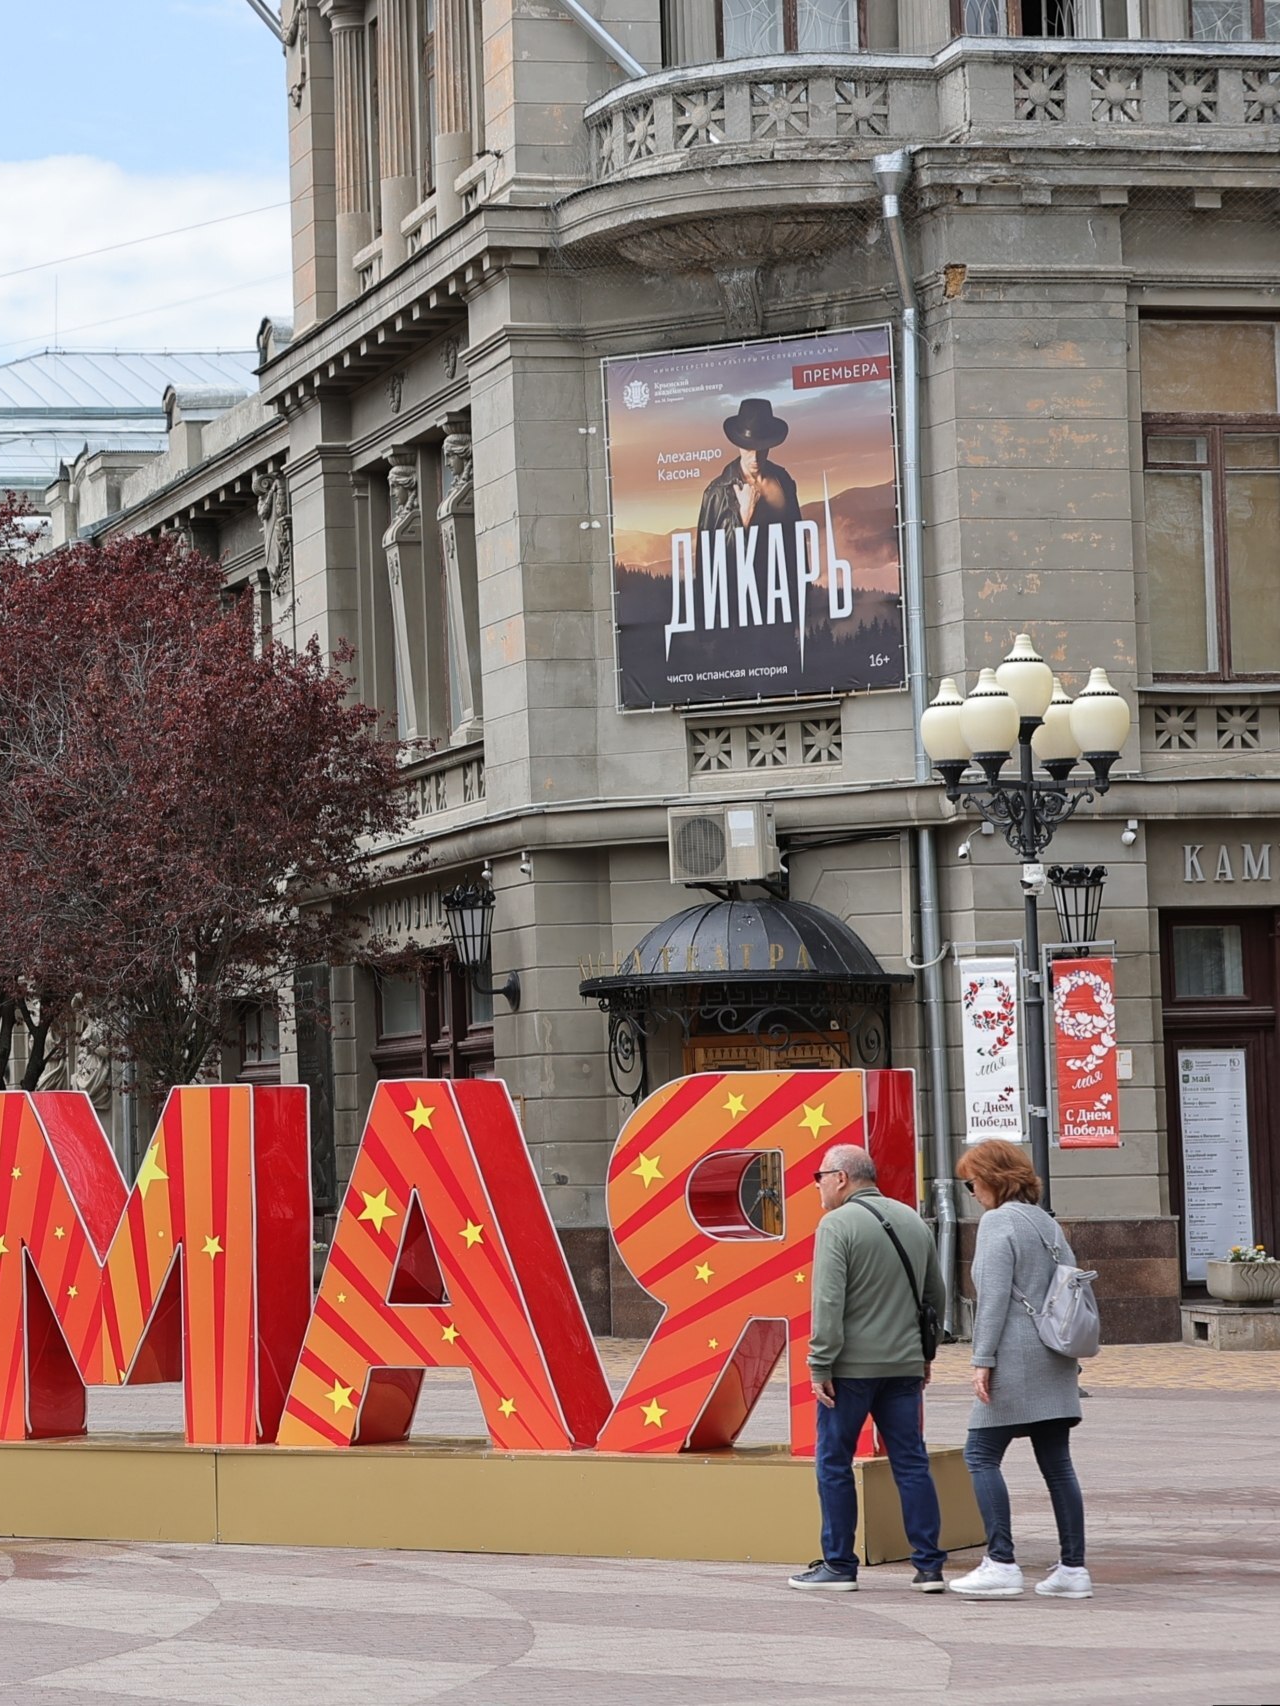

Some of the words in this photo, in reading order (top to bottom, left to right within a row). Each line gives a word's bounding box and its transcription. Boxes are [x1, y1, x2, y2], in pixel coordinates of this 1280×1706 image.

[653, 361, 715, 374] МИНИСТЕРСТВО
[718, 356, 758, 366] КУЛЬТУРЫ
[761, 350, 814, 361] РЕСПУБЛИКИ
[803, 363, 879, 383] ПРЕМЬЕРА
[654, 379, 689, 390] Крымский
[657, 448, 722, 464] Алехандро
[657, 468, 700, 481] Касона
[664, 469, 853, 674] ДИКАРЬ
[869, 653, 891, 667] 16+
[667, 673, 694, 683] чисто
[696, 668, 746, 681] испанская
[748, 665, 788, 678] история
[1182, 843, 1280, 882] КАМ
[659, 943, 810, 973] ТЕАТРА
[975, 1056, 1007, 1076] мая
[1072, 1071, 1103, 1090] мая
[1191, 1073, 1211, 1083] май
[972, 1102, 980, 1112] С
[982, 1102, 1014, 1114] Днем
[1065, 1110, 1074, 1121] С
[1077, 1109, 1112, 1123] Днем
[970, 1116, 1017, 1128] Победы
[1064, 1124, 1114, 1137] Победы
